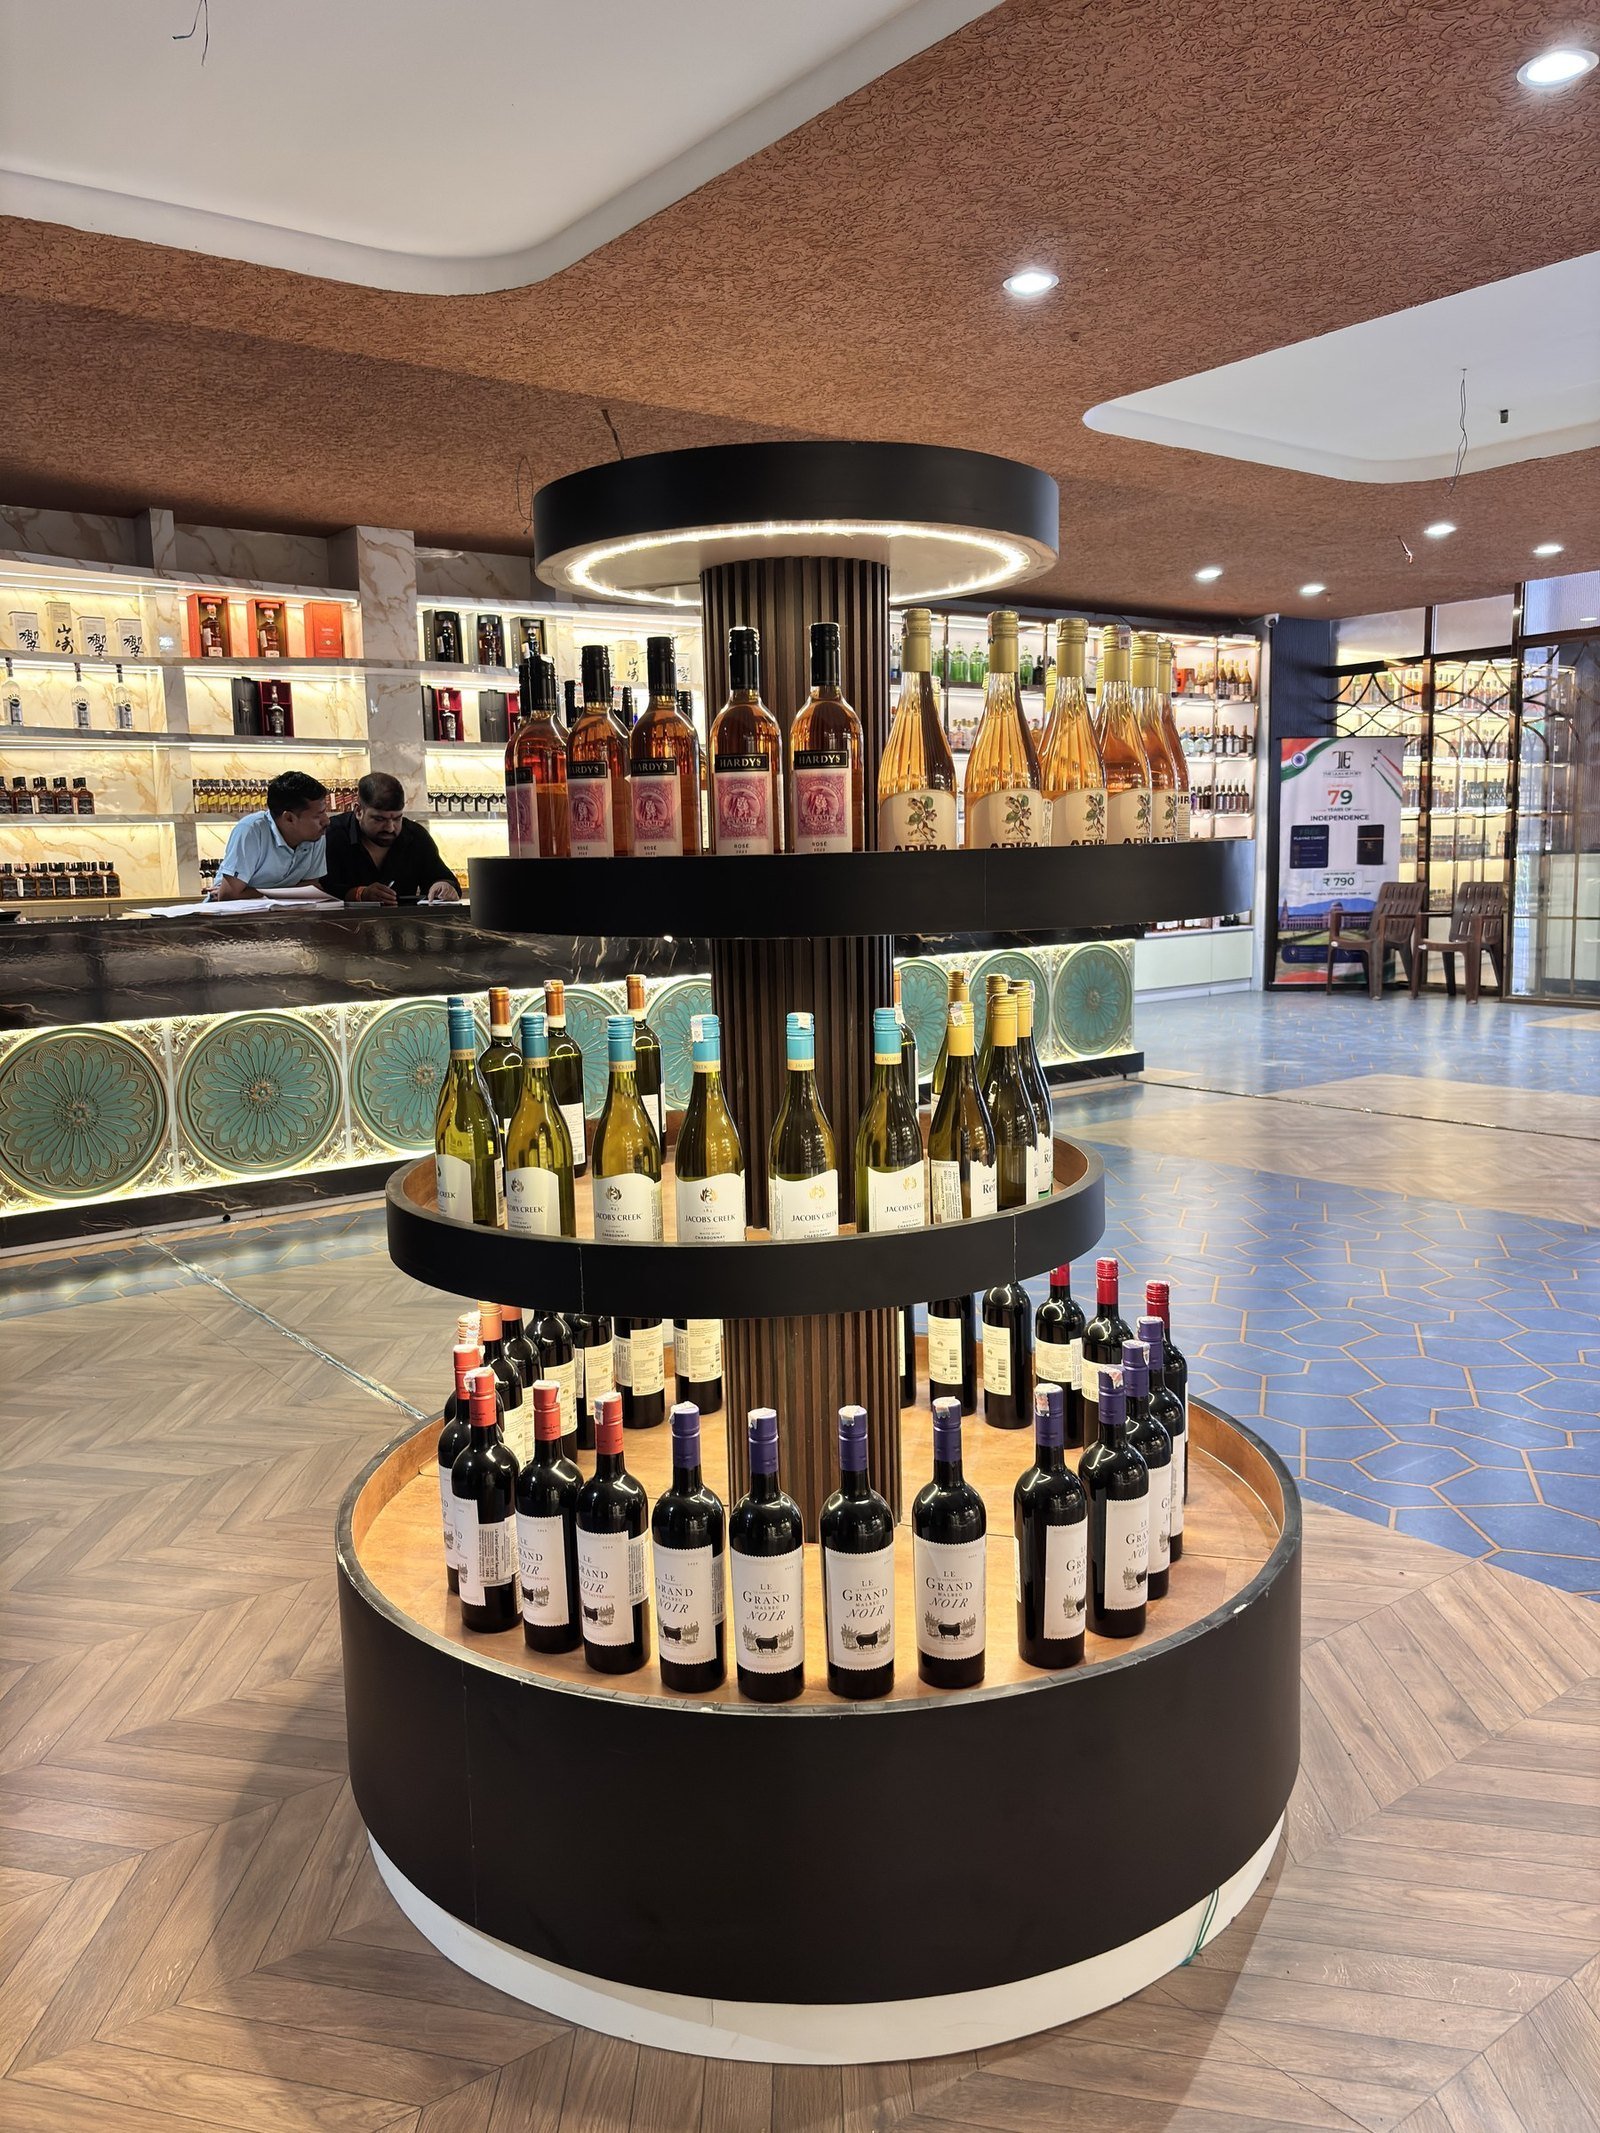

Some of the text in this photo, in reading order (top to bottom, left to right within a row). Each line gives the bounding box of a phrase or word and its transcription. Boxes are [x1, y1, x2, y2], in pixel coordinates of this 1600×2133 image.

[720, 758, 762, 768] HARDYS
[799, 754, 841, 764] HARDYS
[1327, 790, 1353, 805] 79
[1333, 877, 1355, 886] 790
[617, 1213, 642, 1221] CREEK
[713, 1214, 736, 1222] CREEK
[583, 1554, 593, 1564] LE
[664, 1573, 676, 1582] LE
[943, 1570, 956, 1578] LE
[656, 1577, 694, 1597] GRAND
[861, 1579, 874, 1587] LE
[925, 1577, 973, 1592] GRAND
[742, 1590, 790, 1605] GRAND
[842, 1587, 889, 1602] GRAND
[929, 1597, 969, 1609] NOIR
[746, 1610, 787, 1622] NOIR
[846, 1604, 885, 1619] NOIR
